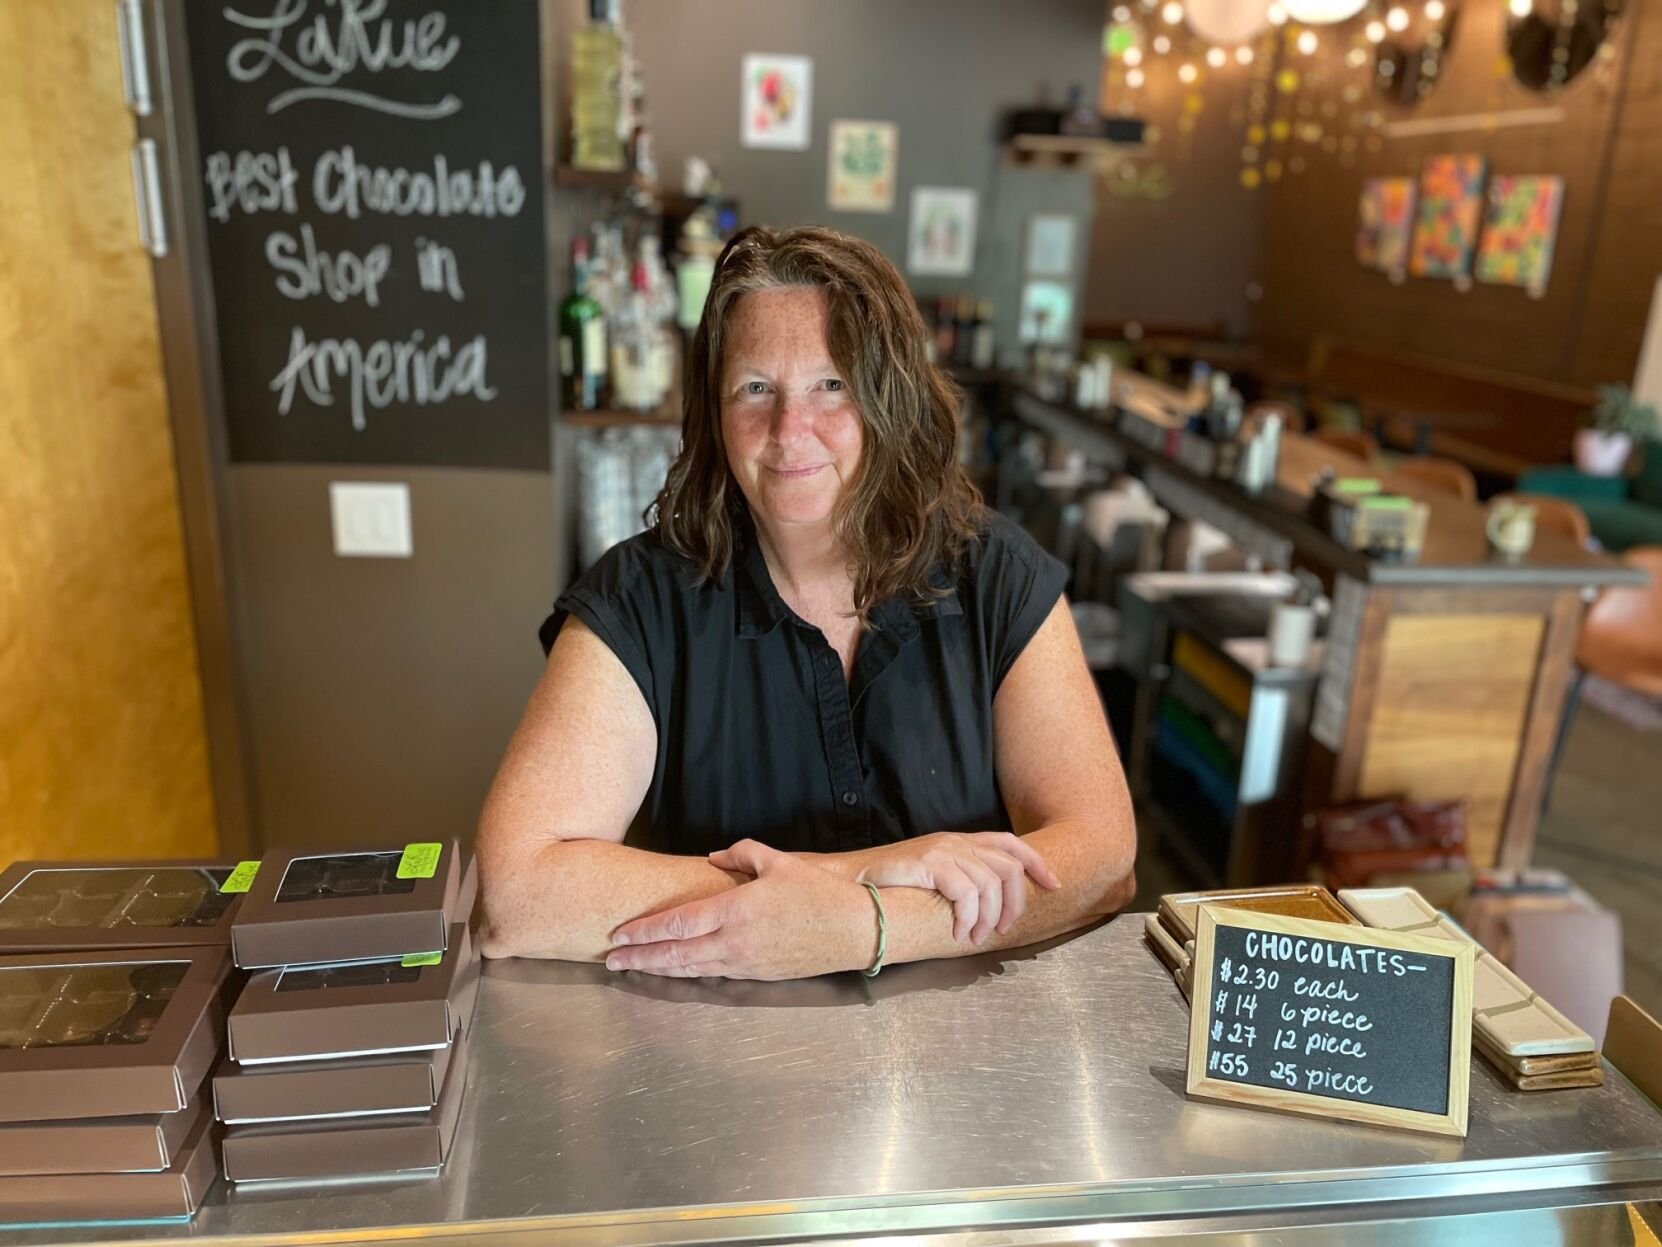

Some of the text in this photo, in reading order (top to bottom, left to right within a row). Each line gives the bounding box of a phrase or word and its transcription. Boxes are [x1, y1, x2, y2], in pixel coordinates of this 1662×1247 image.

[223, 0, 460, 84] LaRue
[265, 222, 465, 307] Shop in
[269, 326, 498, 431] America
[1220, 957, 1359, 1002] $2.30 each
[1281, 1003, 1296, 1021] 6
[1300, 1004, 1373, 1031] piece
[1274, 1029, 1297, 1050] 12
[1305, 1033, 1367, 1058] piece
[1270, 1062, 1298, 1087] 25
[1305, 1067, 1374, 1095] piece
